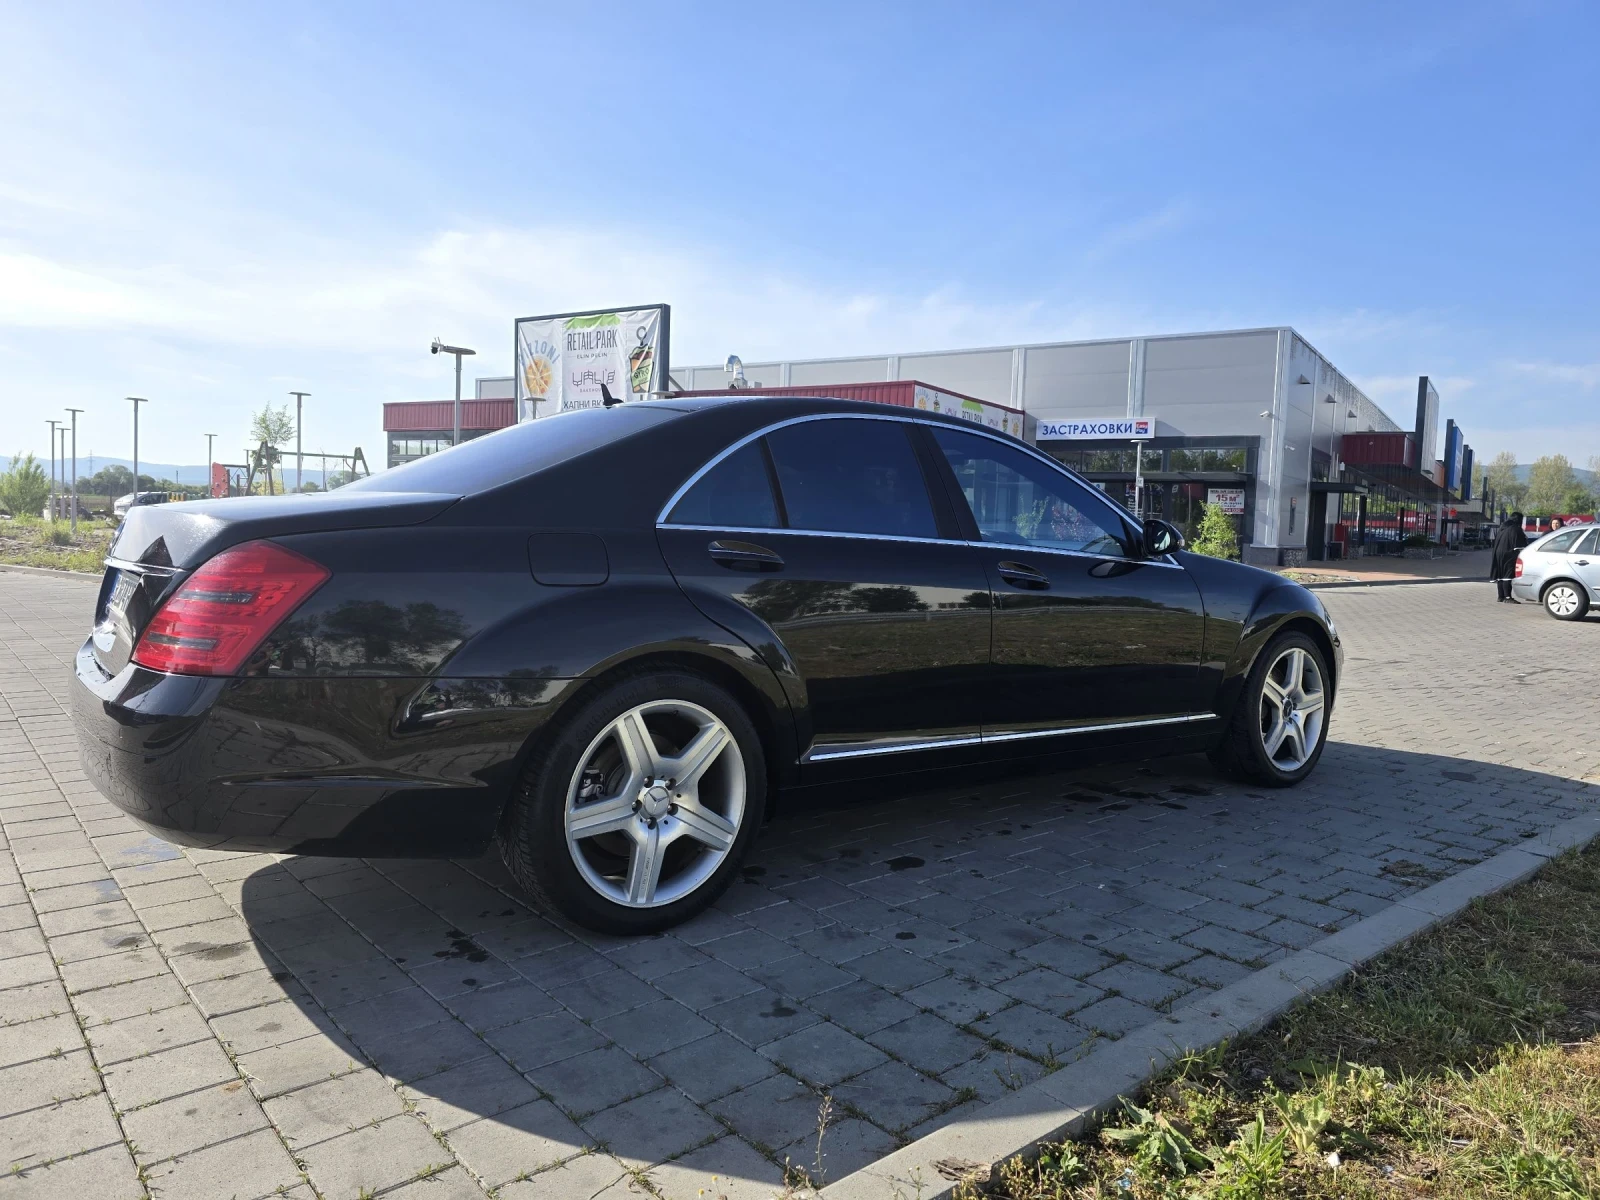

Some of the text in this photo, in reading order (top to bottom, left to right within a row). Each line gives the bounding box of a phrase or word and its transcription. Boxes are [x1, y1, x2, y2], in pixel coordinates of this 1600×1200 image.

[567, 328, 618, 351] RETAIL PARK
[633, 367, 650, 379] GYRO
[1042, 423, 1133, 435] ЗАСТРАХОВКИ
[1215, 493, 1228, 501] 15
